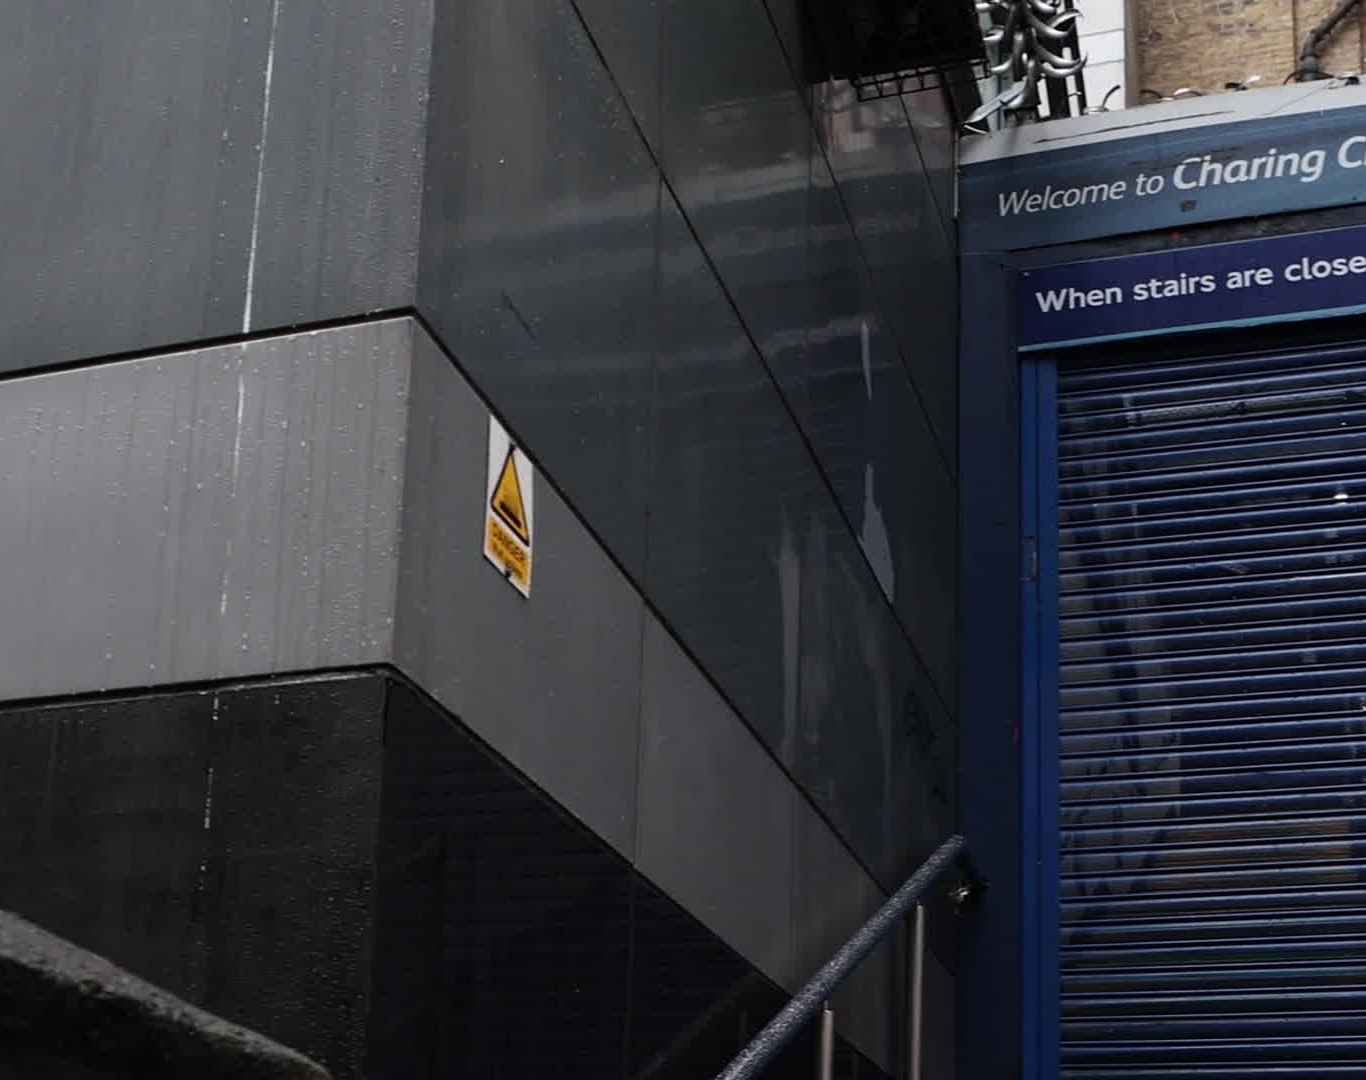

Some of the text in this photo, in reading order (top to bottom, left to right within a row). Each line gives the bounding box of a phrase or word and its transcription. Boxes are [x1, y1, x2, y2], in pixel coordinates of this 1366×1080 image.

[998, 177, 1126, 217] Welcome
[1135, 172, 1164, 195] to
[1173, 147, 1325, 190] Charing
[1035, 284, 1122, 312] When
[1133, 272, 1216, 301] stairs
[1226, 267, 1274, 289] are
